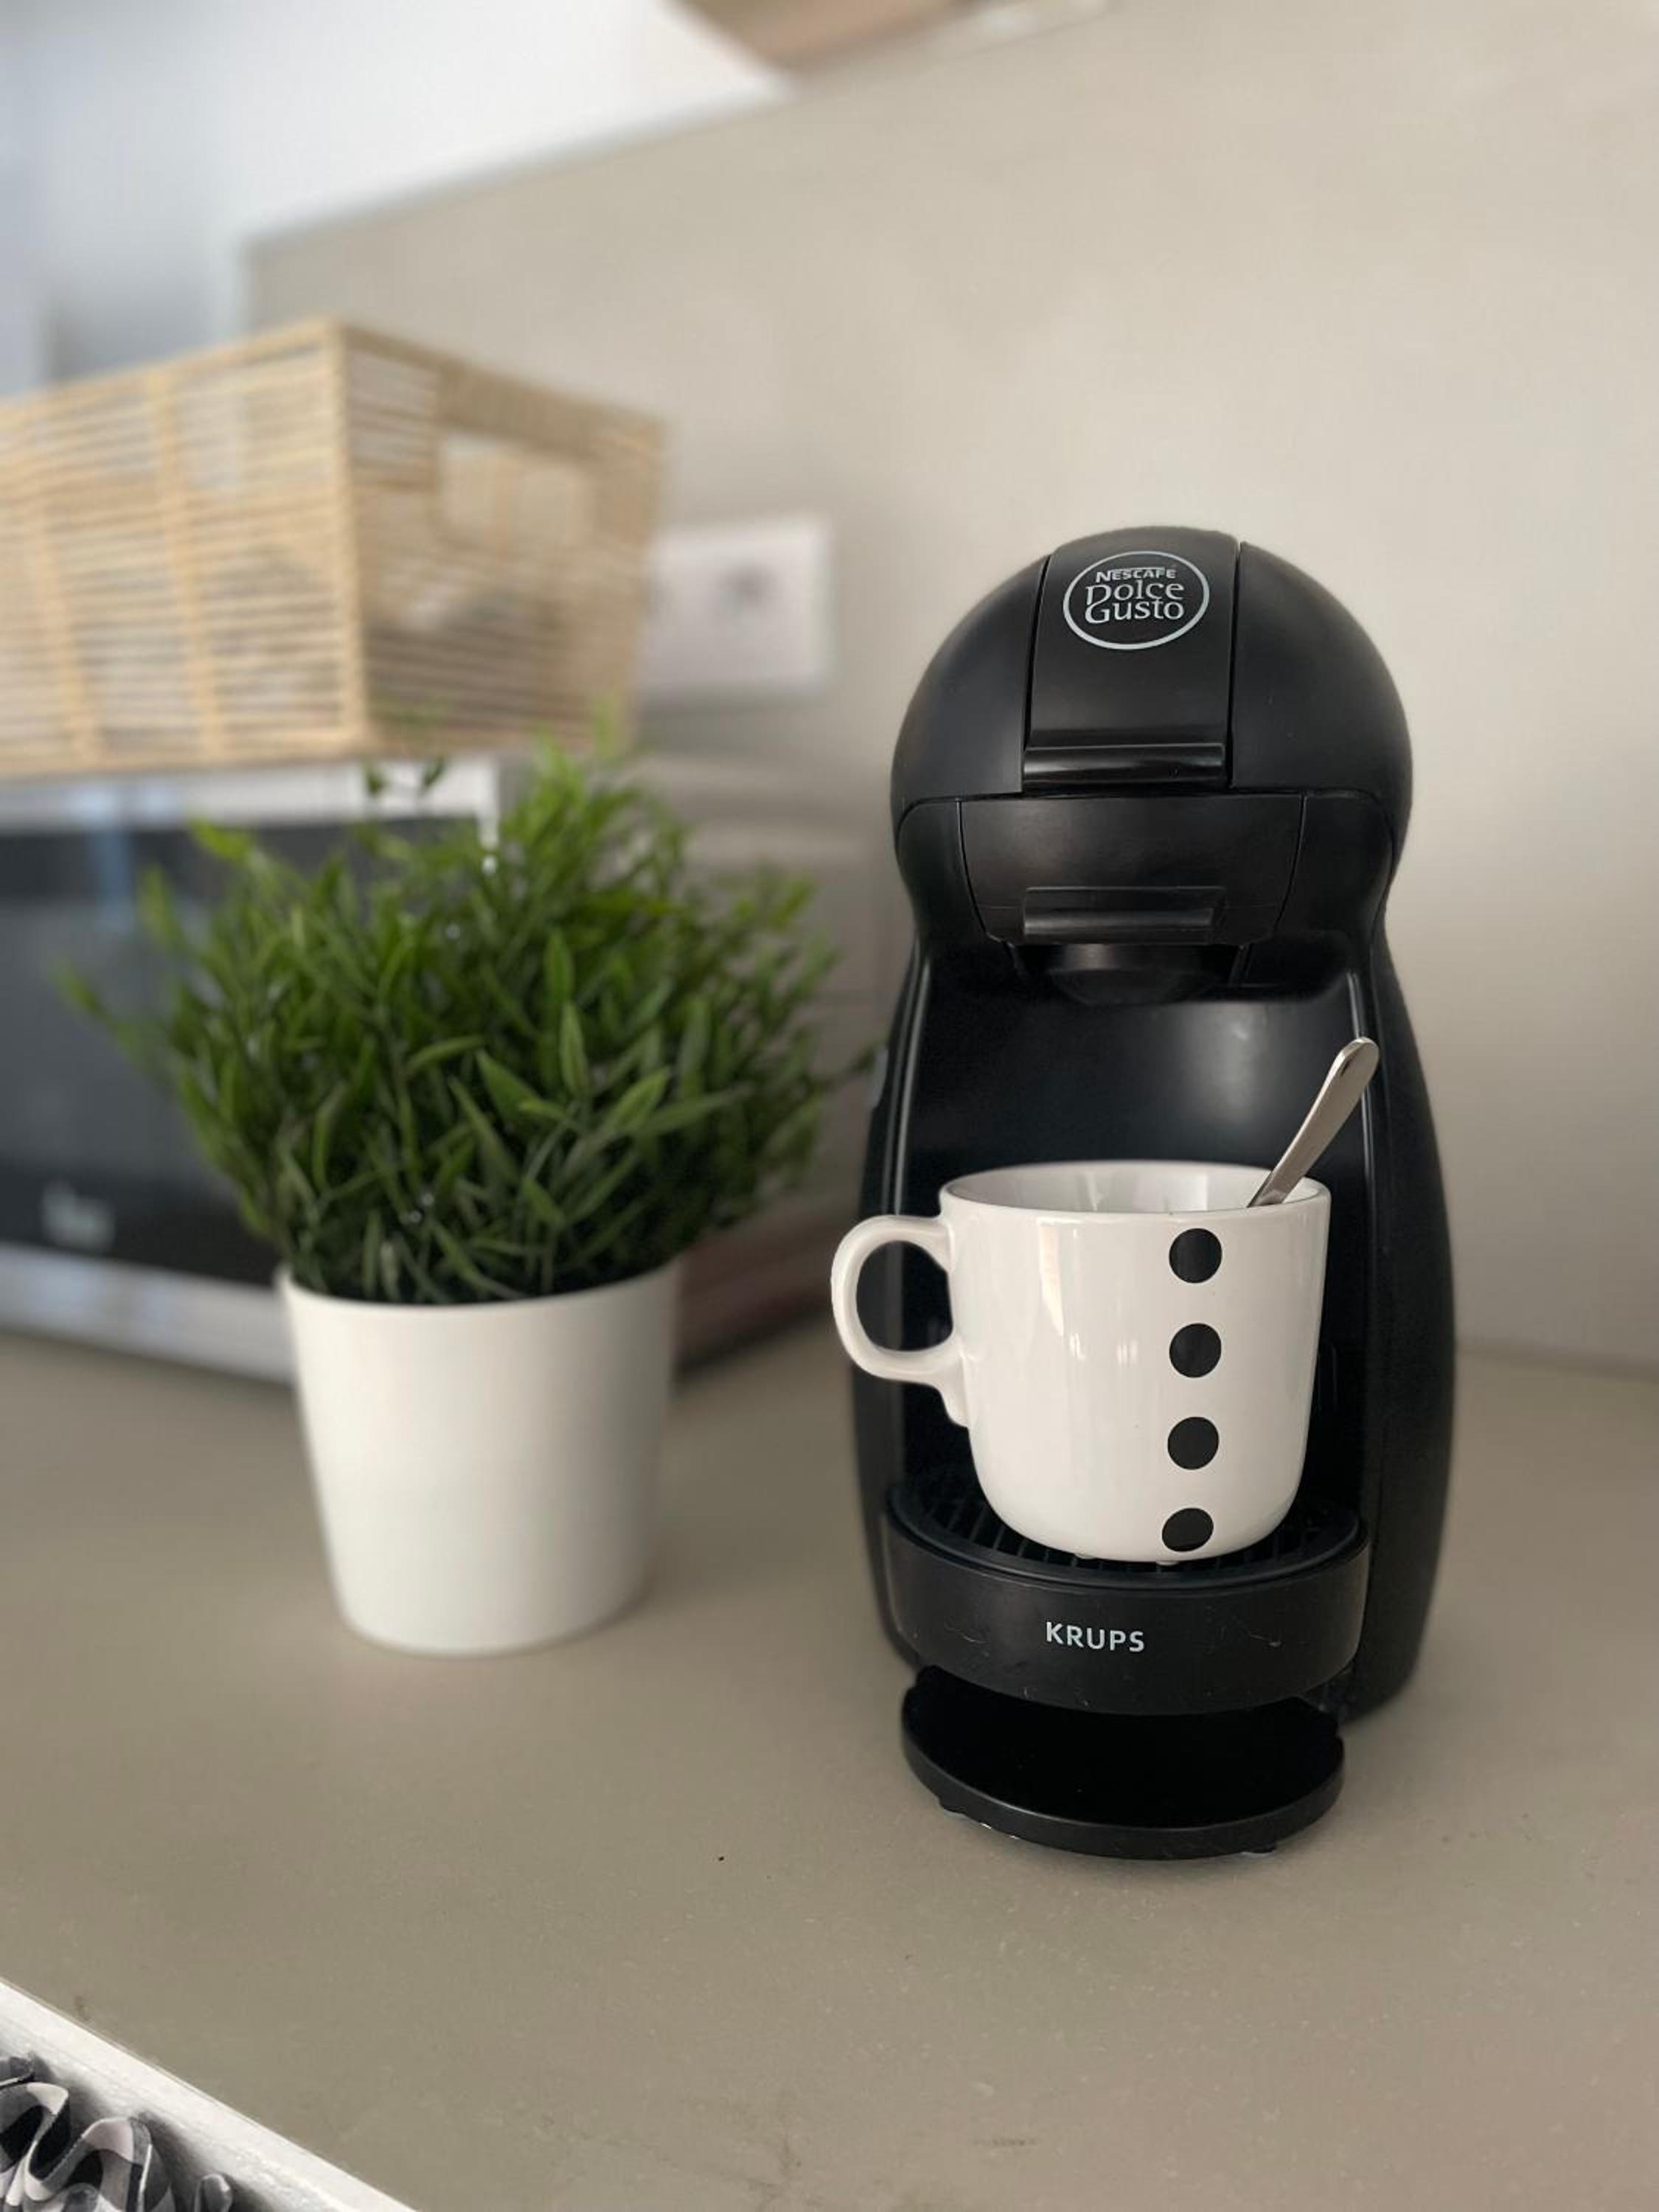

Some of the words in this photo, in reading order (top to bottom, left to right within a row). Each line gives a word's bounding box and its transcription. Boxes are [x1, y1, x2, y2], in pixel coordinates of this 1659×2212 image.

[1085, 580, 1184, 605] Dolce
[1085, 599, 1184, 624] Gusto
[1046, 1621, 1144, 1652] KRUPS
